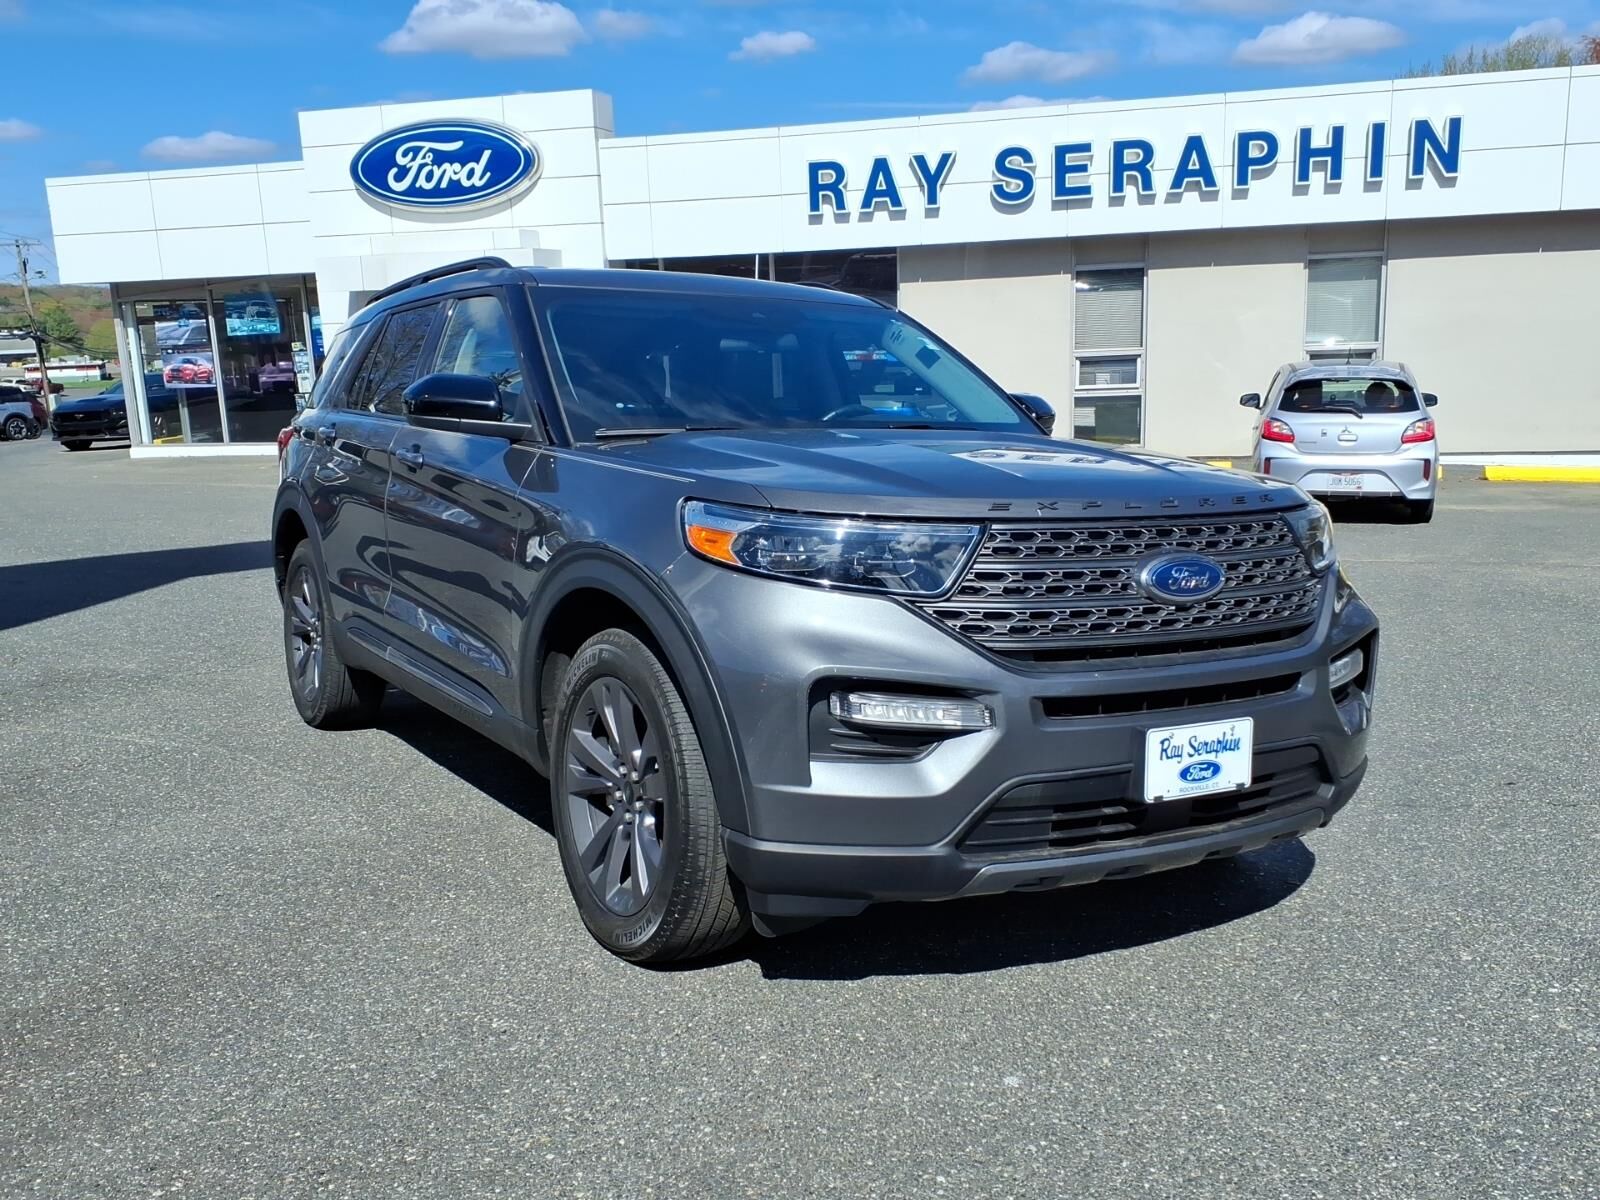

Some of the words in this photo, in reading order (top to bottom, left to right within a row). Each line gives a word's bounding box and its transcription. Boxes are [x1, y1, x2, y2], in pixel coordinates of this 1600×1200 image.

[387, 139, 492, 192] Ford
[807, 152, 954, 213] RAY
[991, 115, 1463, 203] SERAPHIN
[987, 493, 1275, 512] EXPLORER
[1167, 565, 1211, 591] Ford
[1159, 737, 1185, 764] Ray
[1187, 731, 1242, 759] Seraphin
[1186, 764, 1214, 780] Ford
[614, 914, 653, 944] MICHELIN
